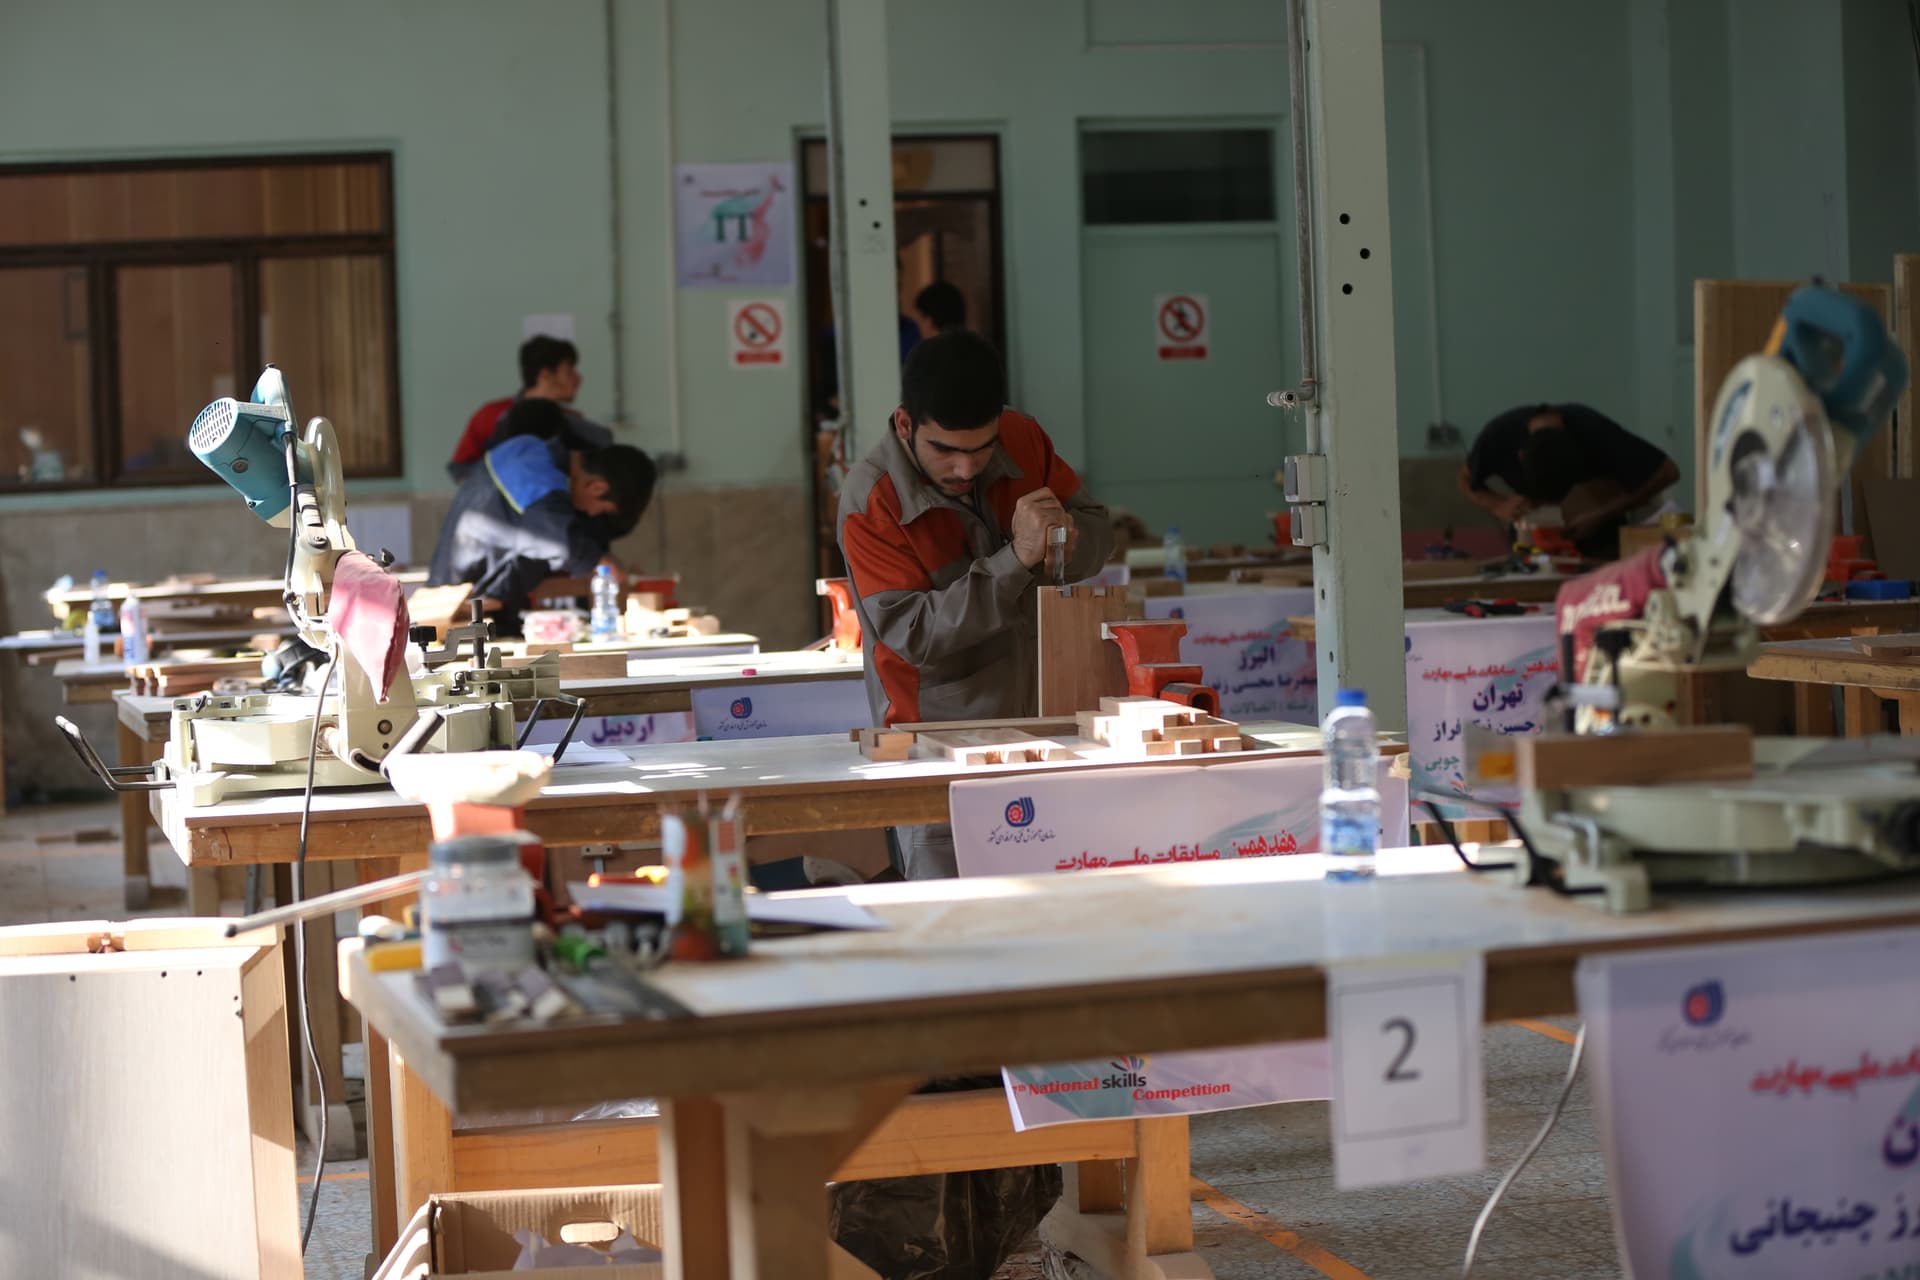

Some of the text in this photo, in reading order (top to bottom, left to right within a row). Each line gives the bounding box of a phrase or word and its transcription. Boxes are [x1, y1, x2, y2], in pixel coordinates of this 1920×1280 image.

[1238, 645, 1275, 671] البرز
[1473, 682, 1524, 711] تهران
[592, 714, 657, 744] اردبیل
[1055, 851, 1107, 872] مهارت
[1151, 843, 1220, 864] مسابقات
[1381, 1016, 1421, 1084] 2
[1028, 1077, 1099, 1096] National
[1102, 1072, 1147, 1090] skills
[1132, 1083, 1232, 1101] Competition
